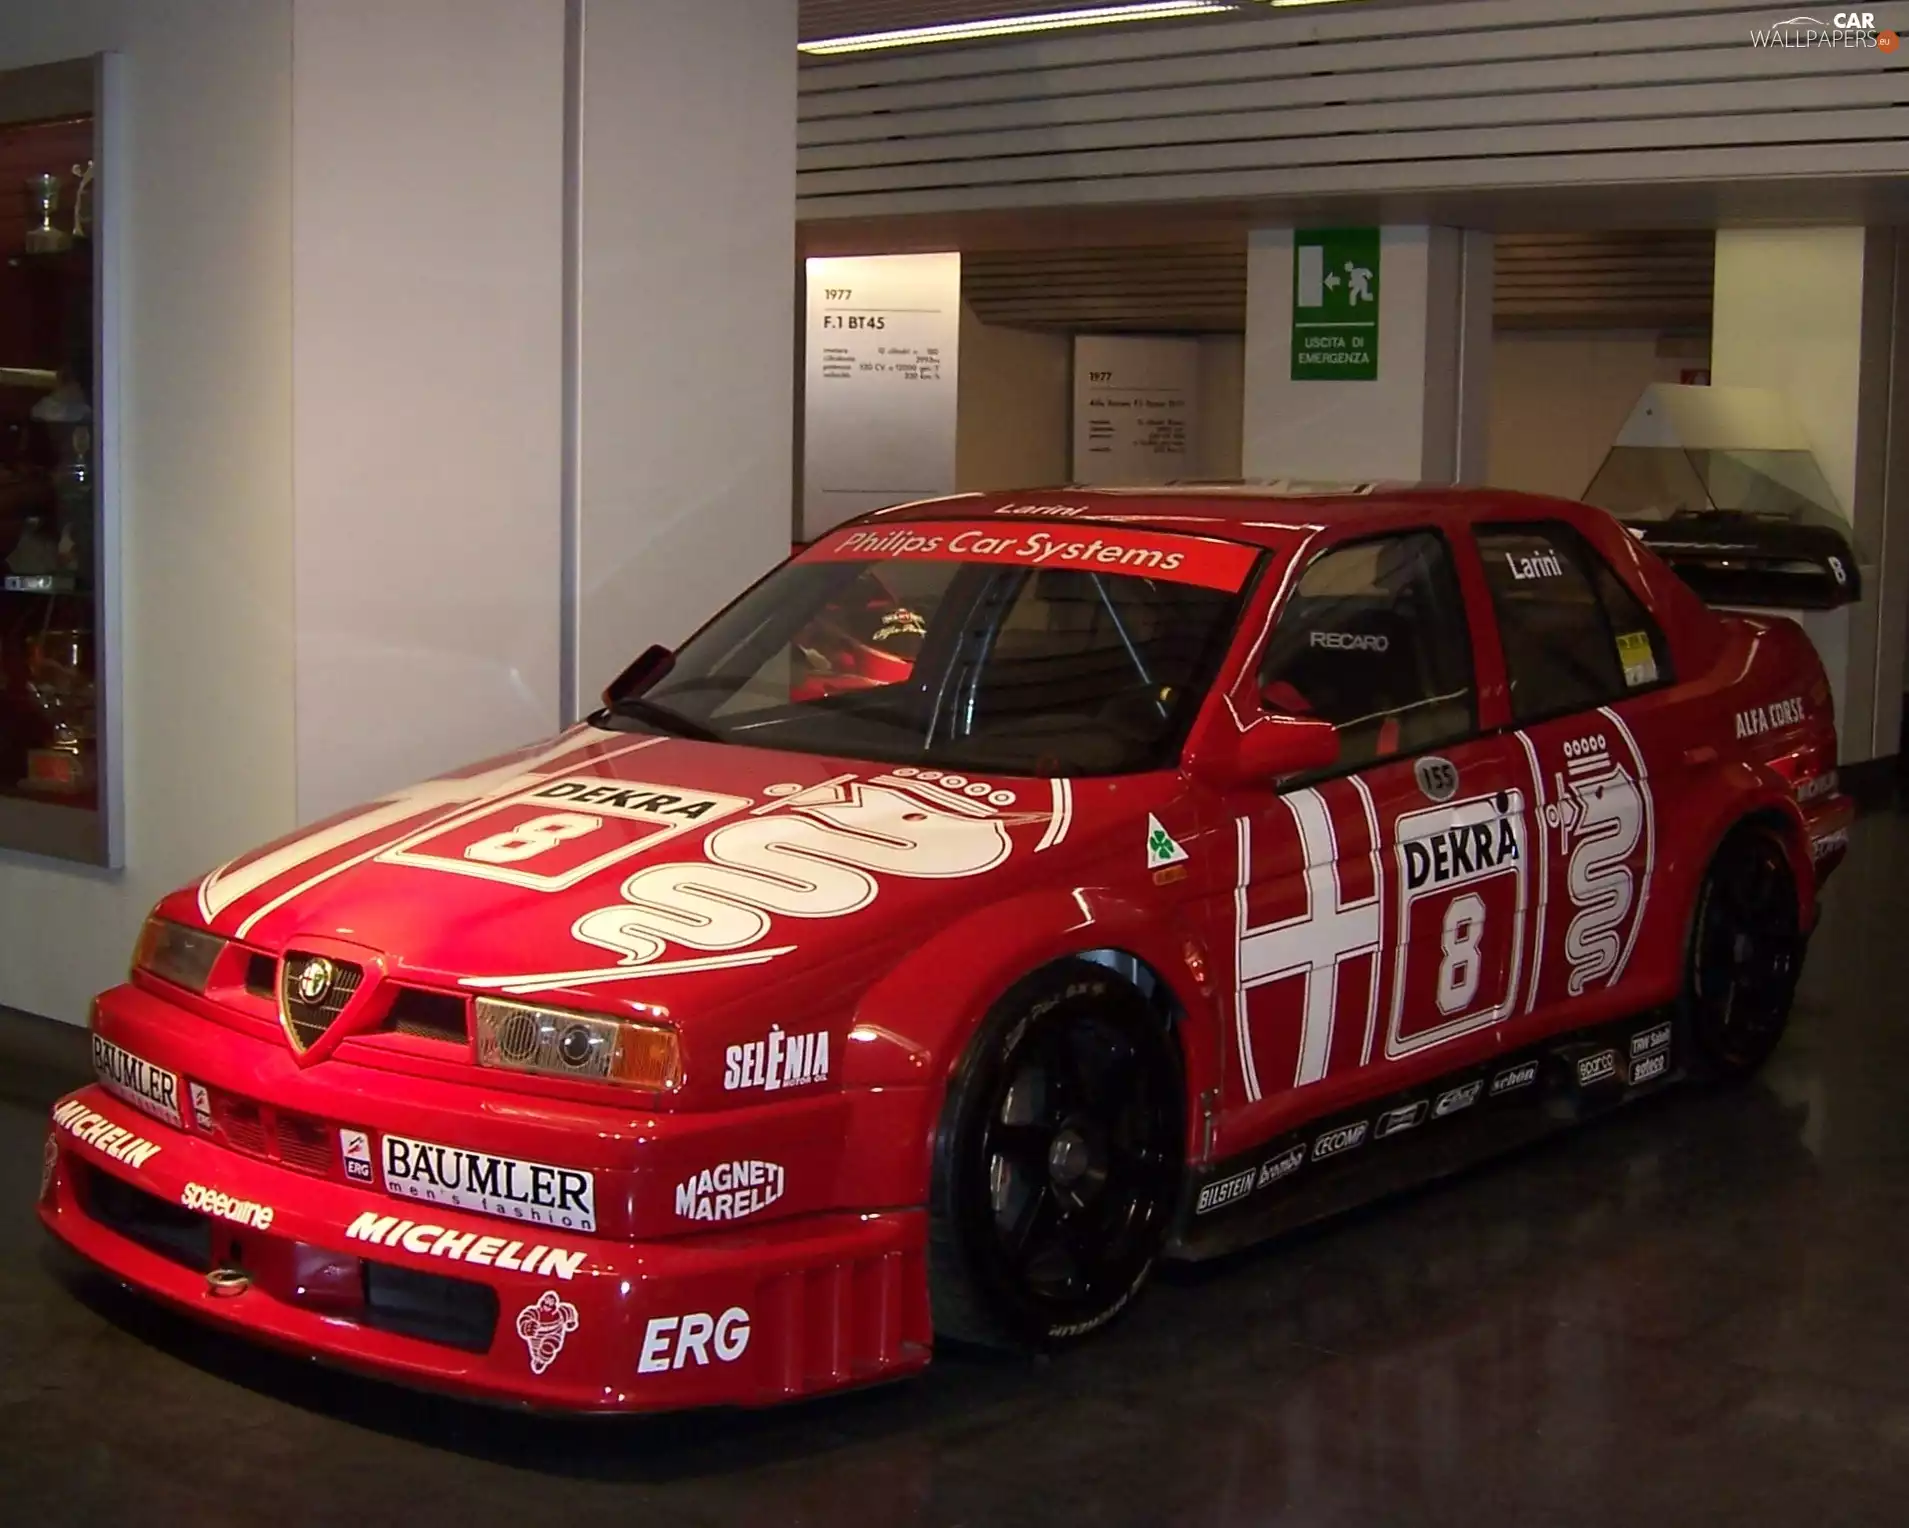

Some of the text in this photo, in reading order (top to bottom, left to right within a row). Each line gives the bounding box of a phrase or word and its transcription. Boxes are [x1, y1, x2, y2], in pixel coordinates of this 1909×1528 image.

[824, 289, 852, 300] 1977
[823, 315, 885, 329] F.1 BT45
[1298, 352, 1370, 364] EMERGENZA
[1304, 336, 1364, 348] USCITA DI
[1089, 371, 1112, 381] 1977
[994, 503, 1089, 517] Larini
[834, 530, 1185, 571] Philips Car Systems
[1505, 549, 1562, 580] Larini
[1310, 631, 1389, 652] RECARO
[1736, 697, 1805, 739] ALFA CORSE
[1423, 765, 1451, 791] 155
[532, 782, 717, 820] DEKRA
[464, 812, 602, 863] 8
[1403, 818, 1520, 890] DEKRA
[1436, 892, 1486, 1016] 8
[1580, 1053, 1613, 1077] sparco
[52, 1100, 162, 1169] MICHELIN
[348, 1161, 370, 1178] ERG
[387, 1138, 590, 1214] BÄUMLER
[676, 1160, 784, 1217] MAGNETI
[389, 1181, 592, 1230] men's fashion
[676, 1167, 784, 1221] MARELLI
[1199, 1171, 1256, 1210] BILSTEIN
[346, 1211, 588, 1280] MICHELIN
[638, 1307, 750, 1373] ERG
